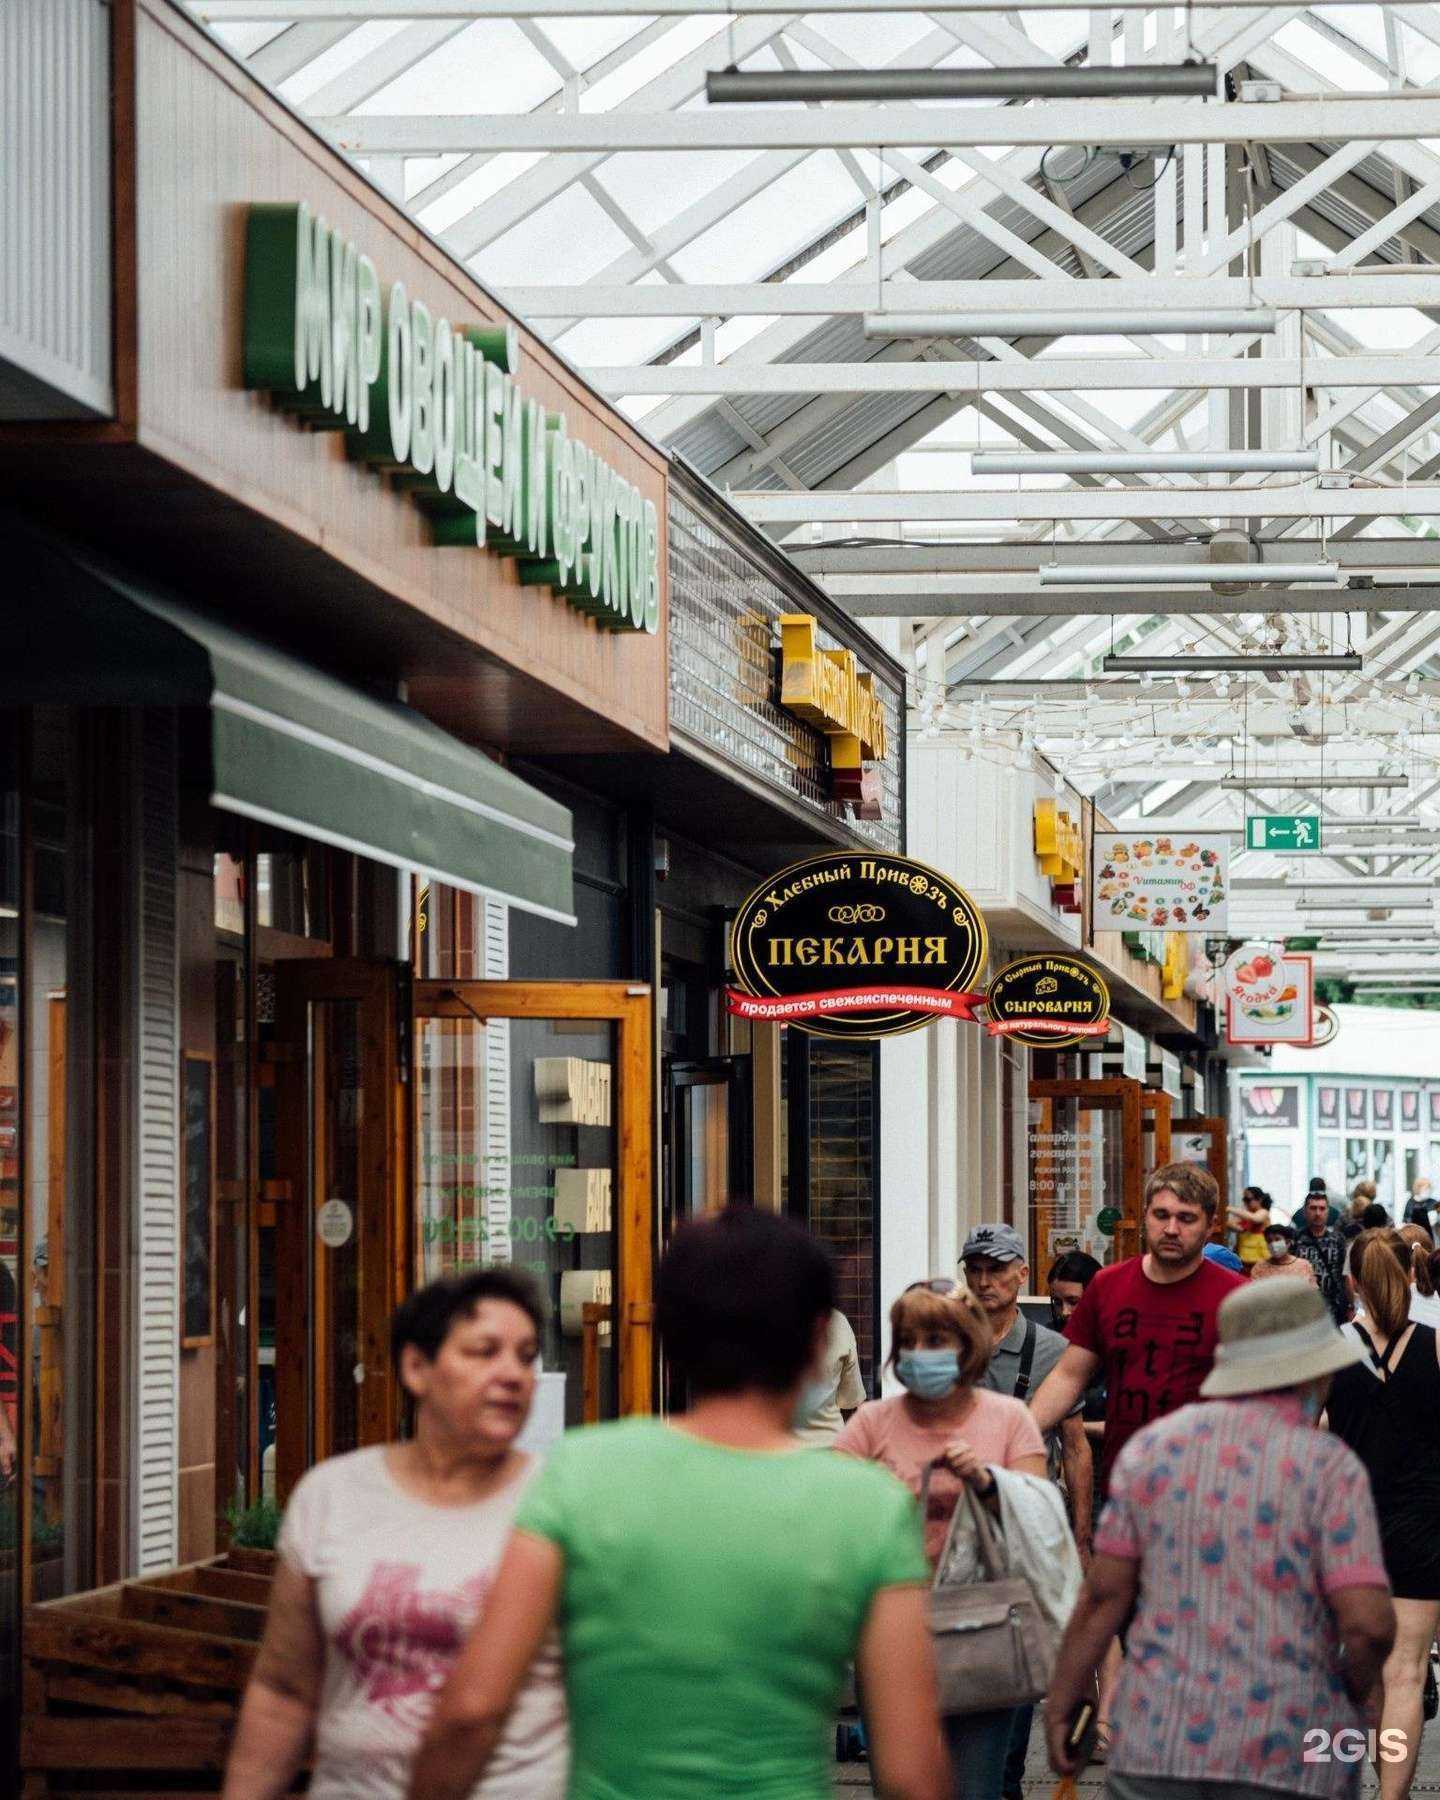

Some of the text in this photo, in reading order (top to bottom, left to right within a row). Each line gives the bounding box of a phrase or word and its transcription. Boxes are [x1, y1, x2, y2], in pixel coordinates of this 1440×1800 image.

[295, 199, 381, 433] МИР
[388, 277, 521, 548] ОВОЩЕЙ
[764, 864, 851, 911] Хлебный
[768, 936, 948, 966] ПЕКАРНЯ
[1004, 962, 1043, 983] Сырный
[740, 993, 953, 1017] продается свежеиспеченным
[1004, 1000, 1093, 1013] СЫРОВАРНЯ
